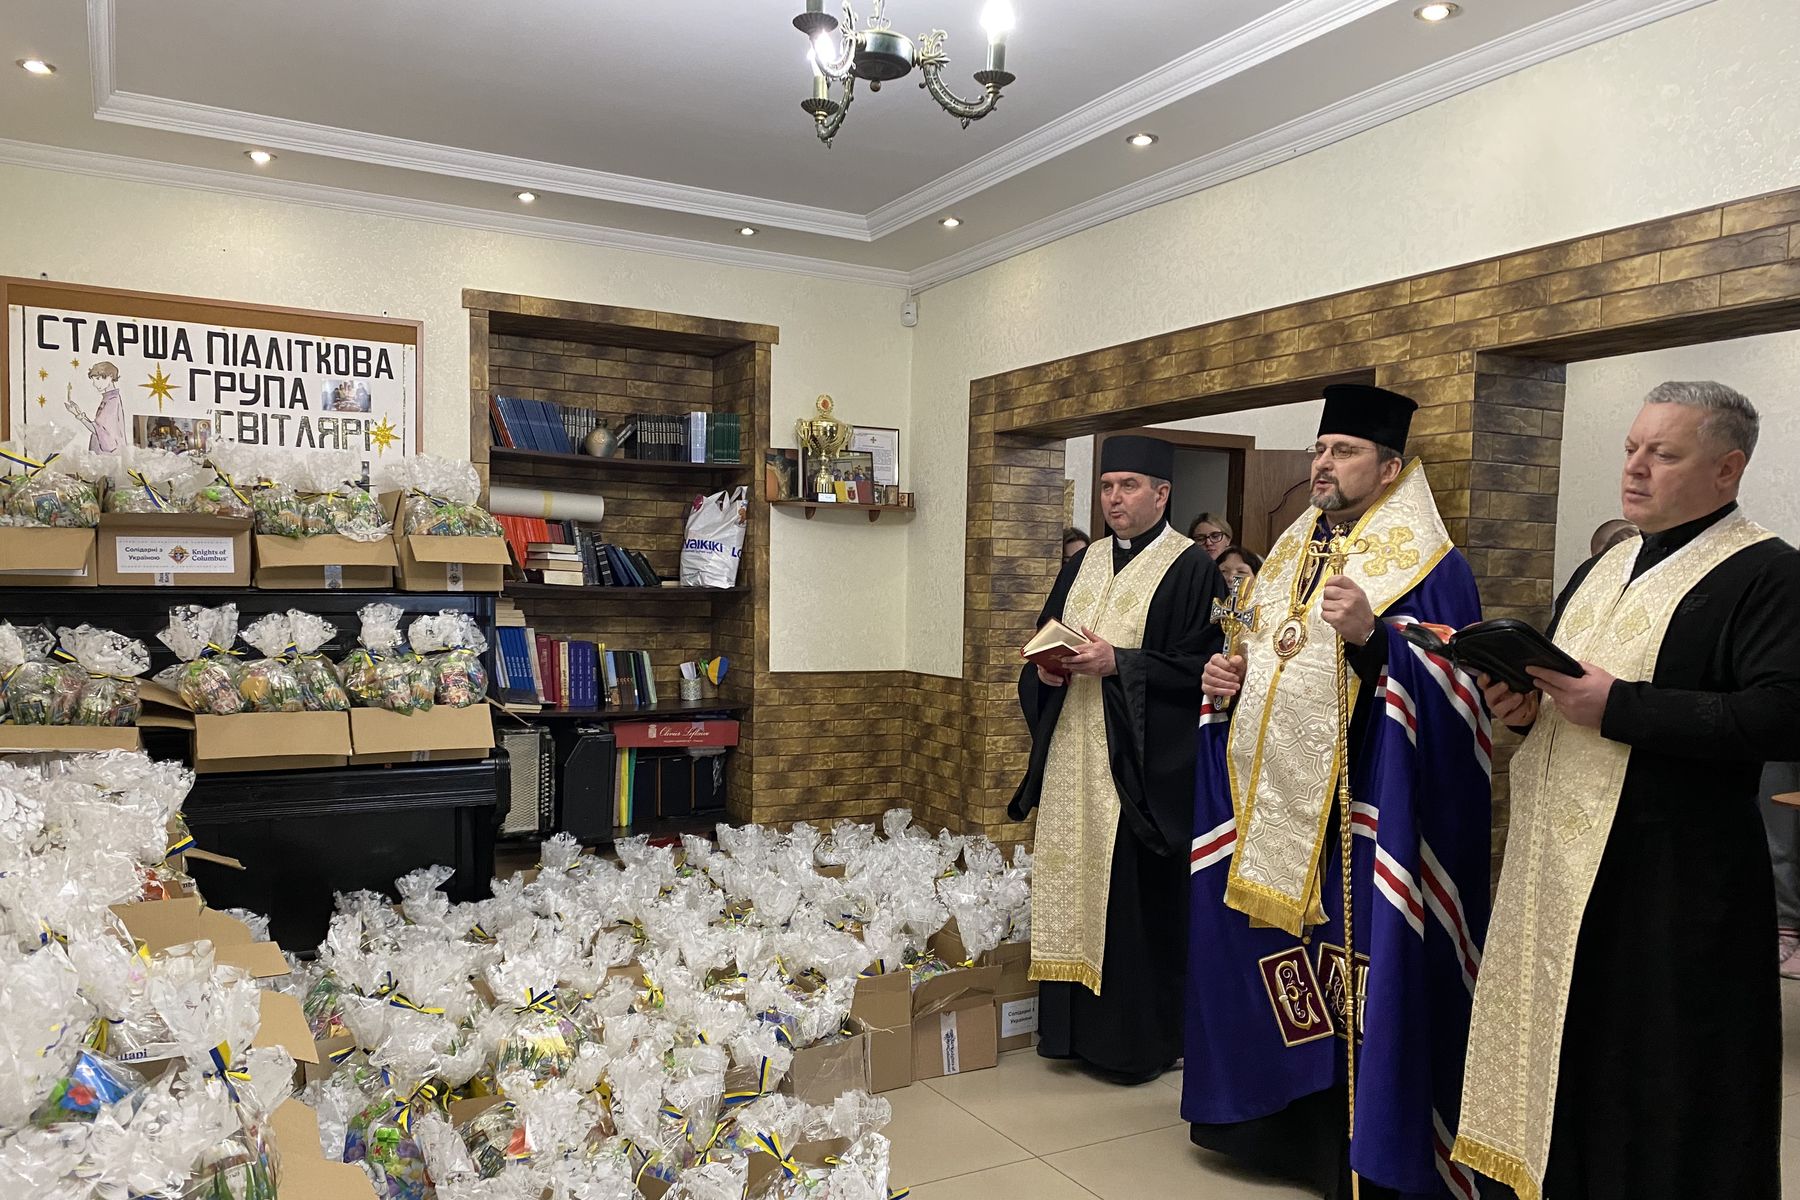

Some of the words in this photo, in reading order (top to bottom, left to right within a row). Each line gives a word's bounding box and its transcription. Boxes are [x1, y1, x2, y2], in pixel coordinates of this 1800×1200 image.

[37, 314, 194, 362] СТАРША
[207, 330, 395, 380] ПІДЛІТКОВА
[188, 368, 309, 410] ГРУПА
